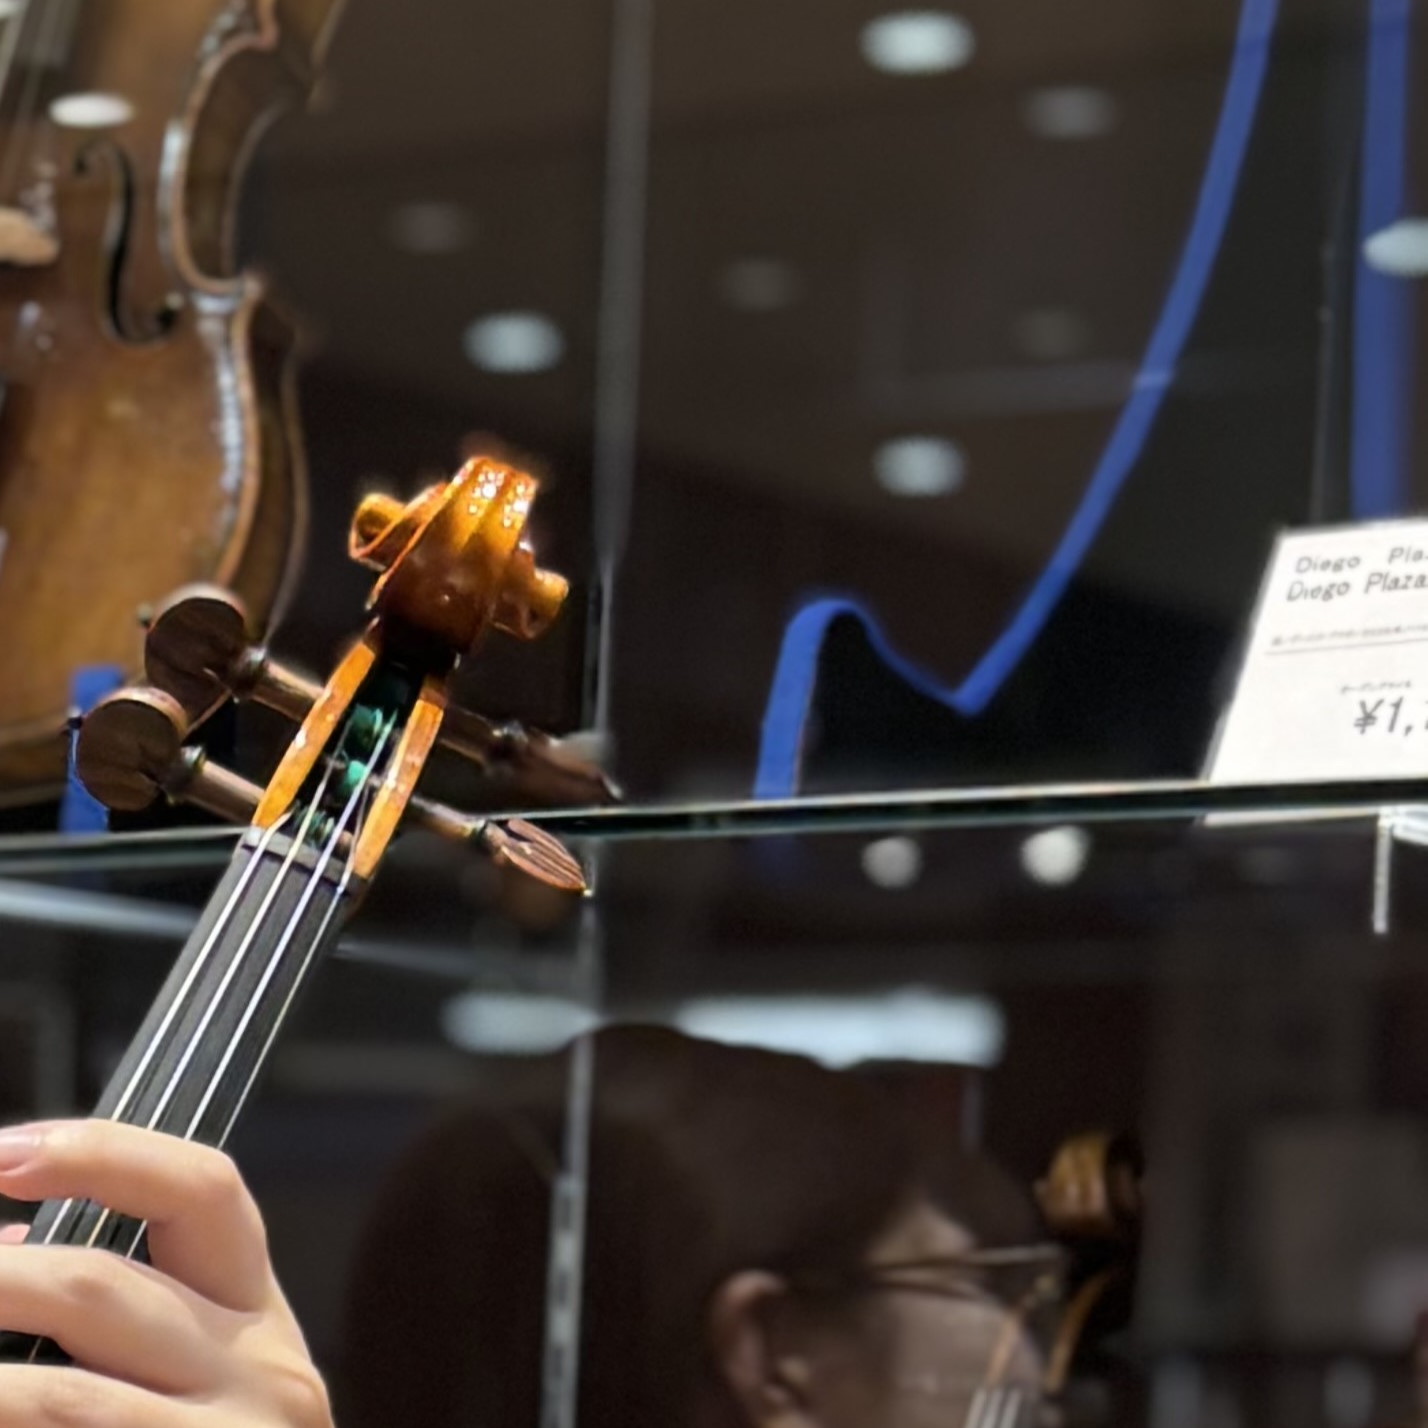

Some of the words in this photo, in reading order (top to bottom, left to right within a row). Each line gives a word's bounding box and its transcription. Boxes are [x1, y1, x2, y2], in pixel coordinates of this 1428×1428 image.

[1295, 555, 1361, 574] Diego
[1388, 546, 1428, 565] Pla
[1286, 579, 1351, 602] Diego
[1353, 696, 1428, 737] ¥1,
